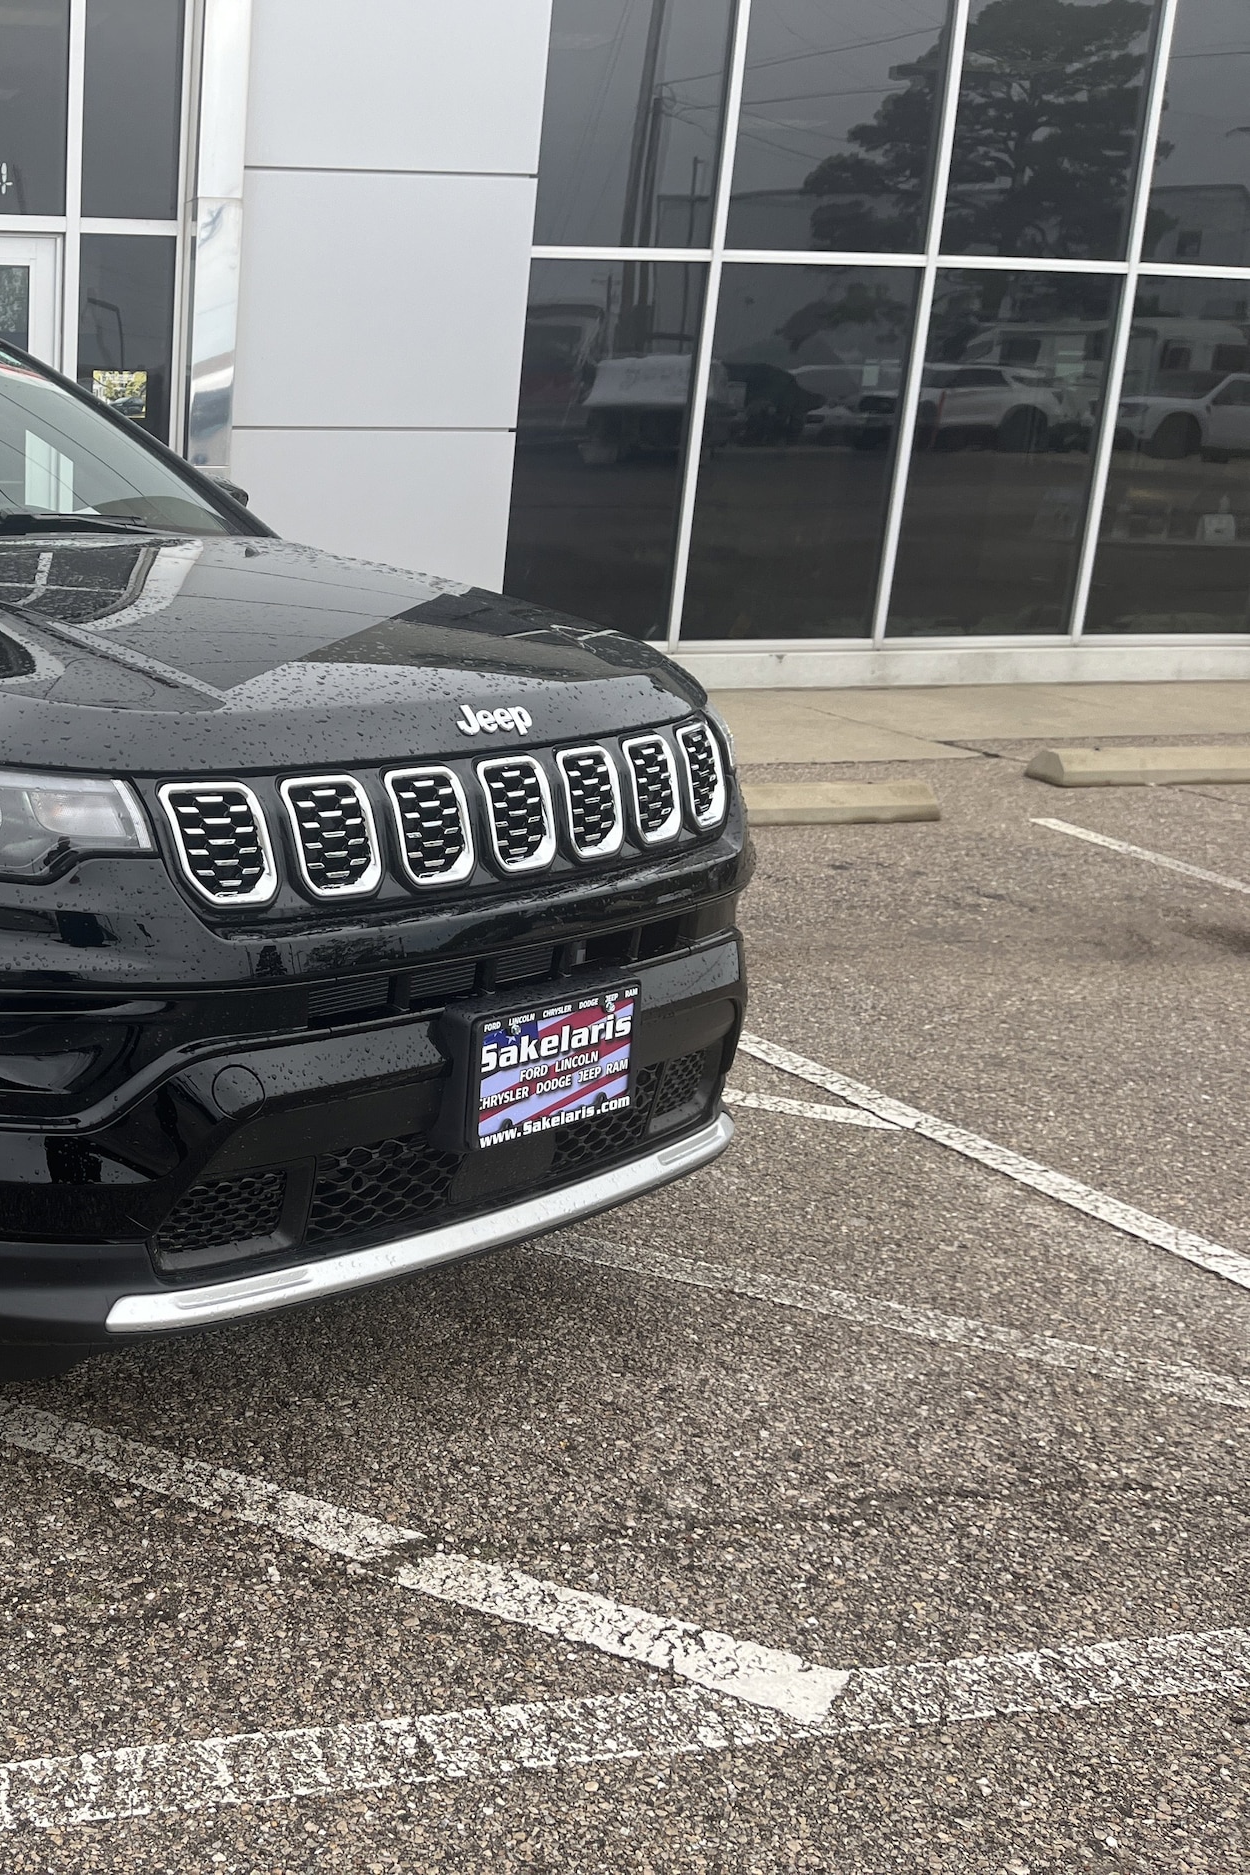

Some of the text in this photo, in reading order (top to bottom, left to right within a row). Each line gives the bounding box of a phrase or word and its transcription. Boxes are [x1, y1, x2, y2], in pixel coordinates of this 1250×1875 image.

[456, 704, 533, 736] Jeep
[483, 987, 639, 1033] FORD LINCOLN CHRYSLER DODGE JEEP RAM
[481, 1014, 632, 1073] Sakelaris
[519, 1051, 599, 1082] FORD LINCOLN
[536, 1075, 572, 1095] DODGE
[578, 1066, 602, 1083] JEEP
[606, 1058, 629, 1075] RAM
[479, 1095, 631, 1149] www.Sakelaris.com
